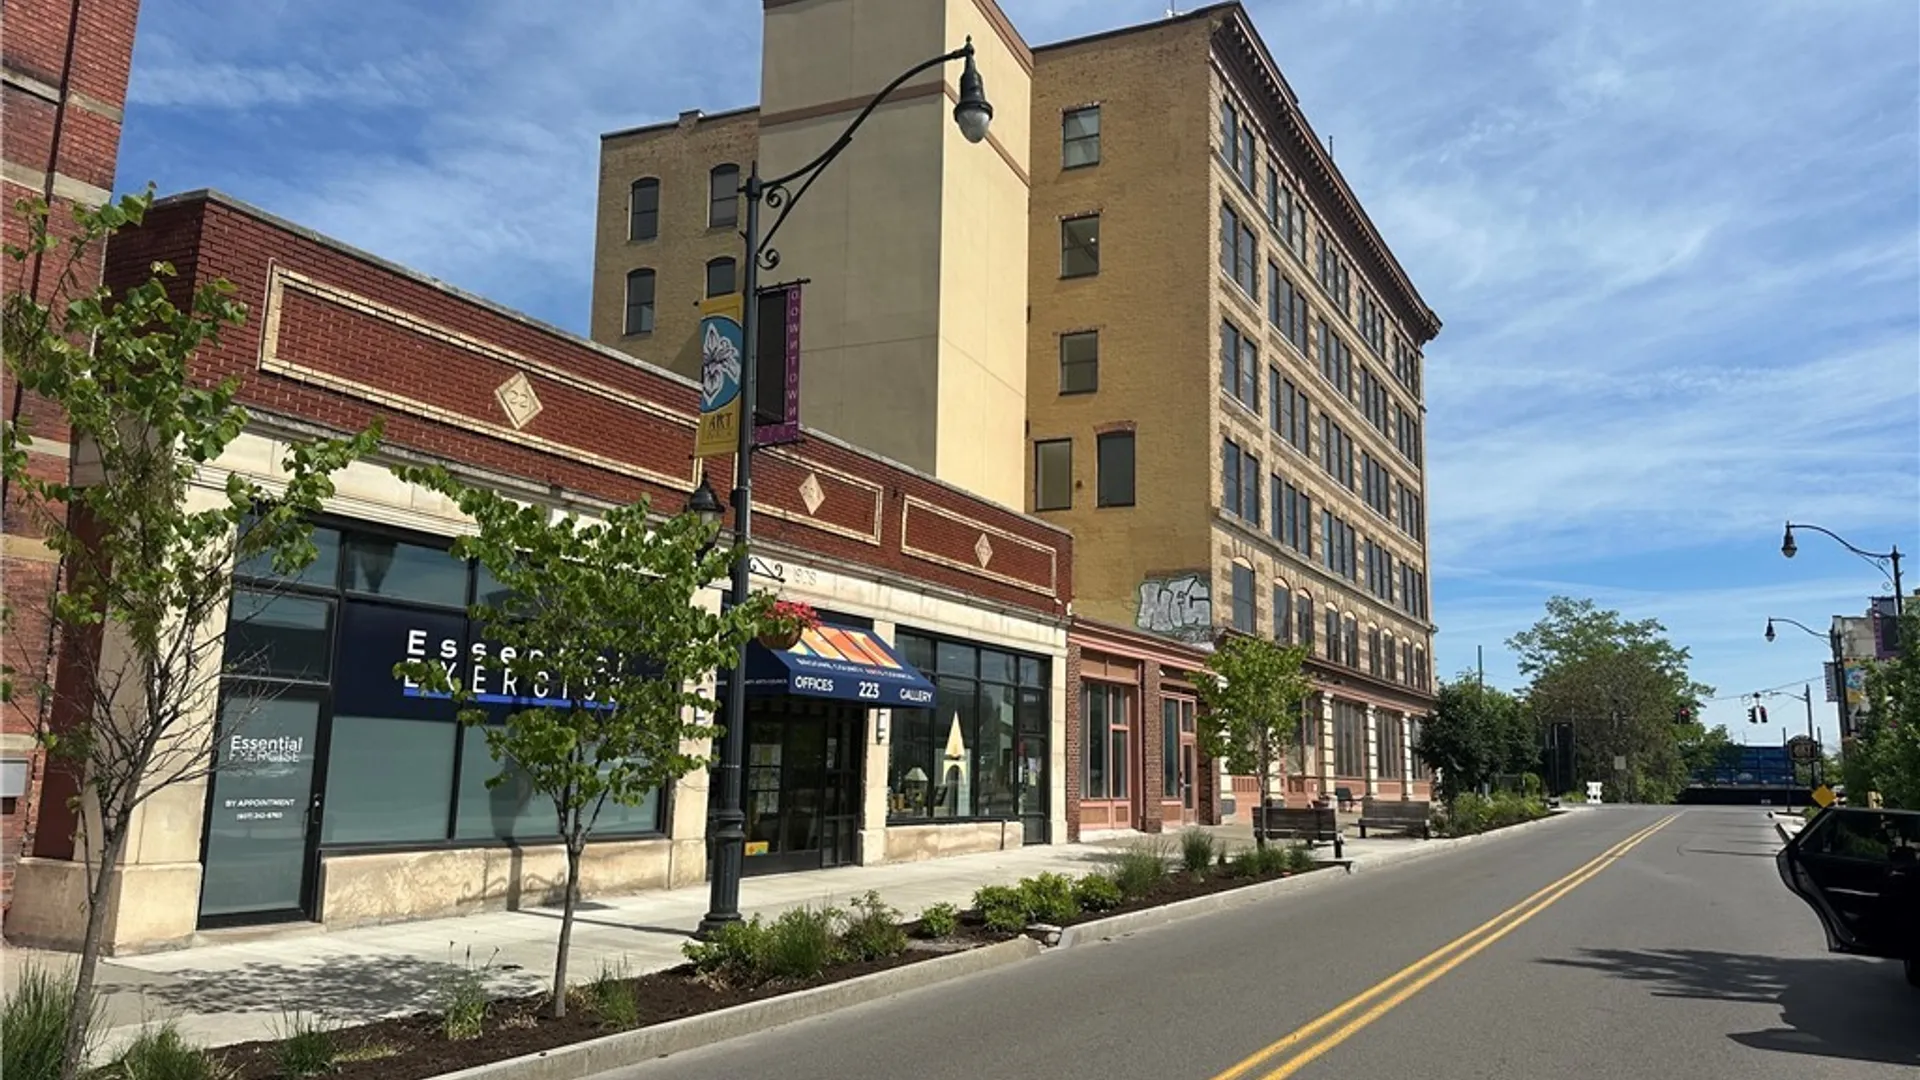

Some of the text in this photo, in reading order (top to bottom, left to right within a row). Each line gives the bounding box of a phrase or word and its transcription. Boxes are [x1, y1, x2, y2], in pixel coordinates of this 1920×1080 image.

[795, 675, 933, 702] OFFICES 223 GALLERY
[230, 735, 303, 752] Essential
[225, 798, 295, 807] BY APPOINTMENT
